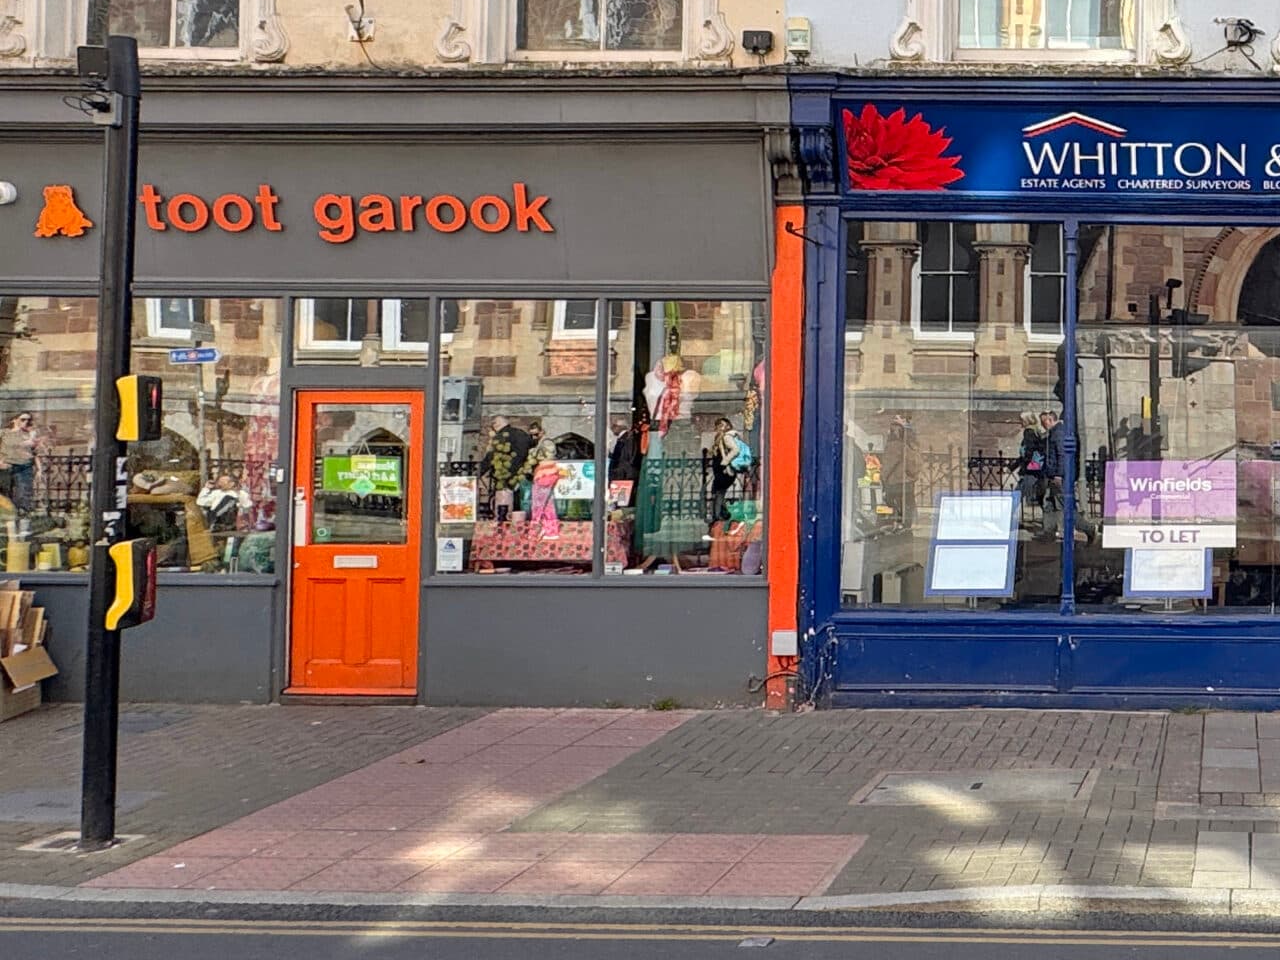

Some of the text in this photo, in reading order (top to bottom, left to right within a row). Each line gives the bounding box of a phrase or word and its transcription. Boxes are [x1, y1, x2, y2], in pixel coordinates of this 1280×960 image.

[1022, 141, 1246, 177] WHITTON
[1021, 178, 1059, 188] ESTATE
[1061, 178, 1106, 189] AGENTS
[1117, 179, 1184, 189] CHARTERED
[1186, 179, 1251, 190] SURVEYORS
[139, 182, 554, 244] toot garook
[1129, 478, 1212, 492] Winfields
[1139, 530, 1200, 543] TO LET
